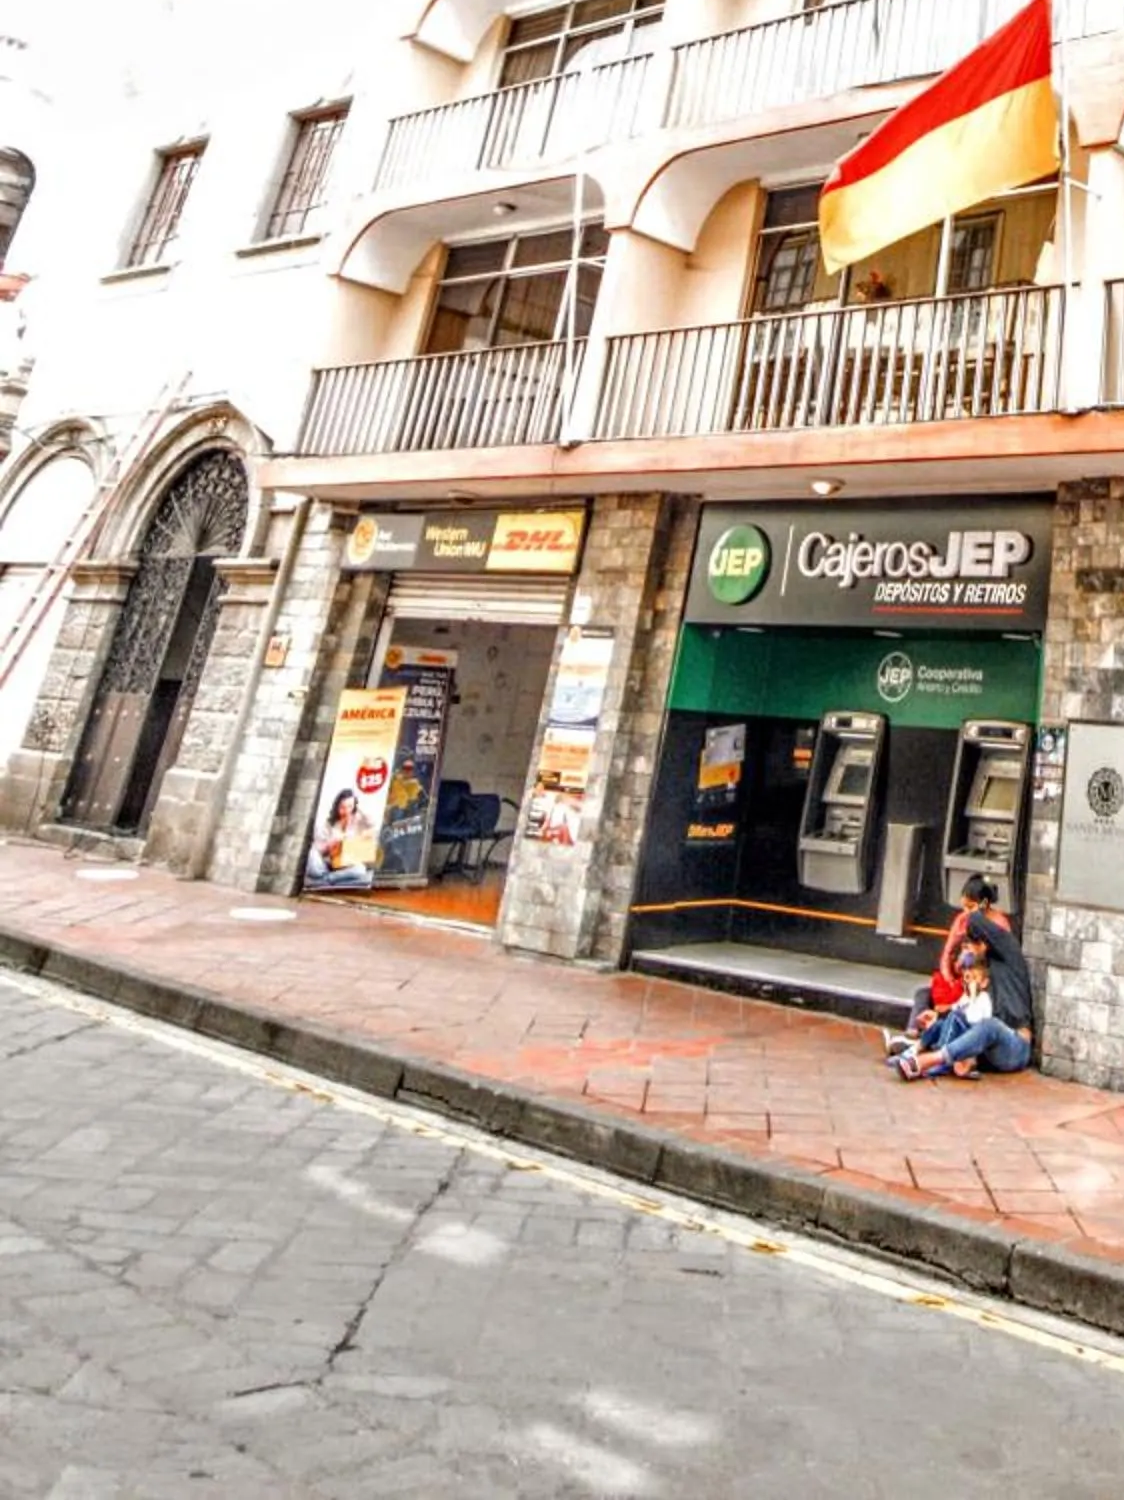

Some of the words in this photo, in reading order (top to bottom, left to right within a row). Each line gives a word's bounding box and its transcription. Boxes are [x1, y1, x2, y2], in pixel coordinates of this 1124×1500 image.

[425, 525, 468, 541] Western
[504, 530, 566, 551] DHL
[709, 547, 762, 577] JEP
[874, 579, 951, 603] DEPÓSITOS
[952, 583, 964, 604] Y
[964, 583, 1027, 605] RETIROS
[880, 665, 912, 684] JEP
[917, 665, 983, 681] Cooperativa
[340, 705, 396, 720] AMÉRICA
